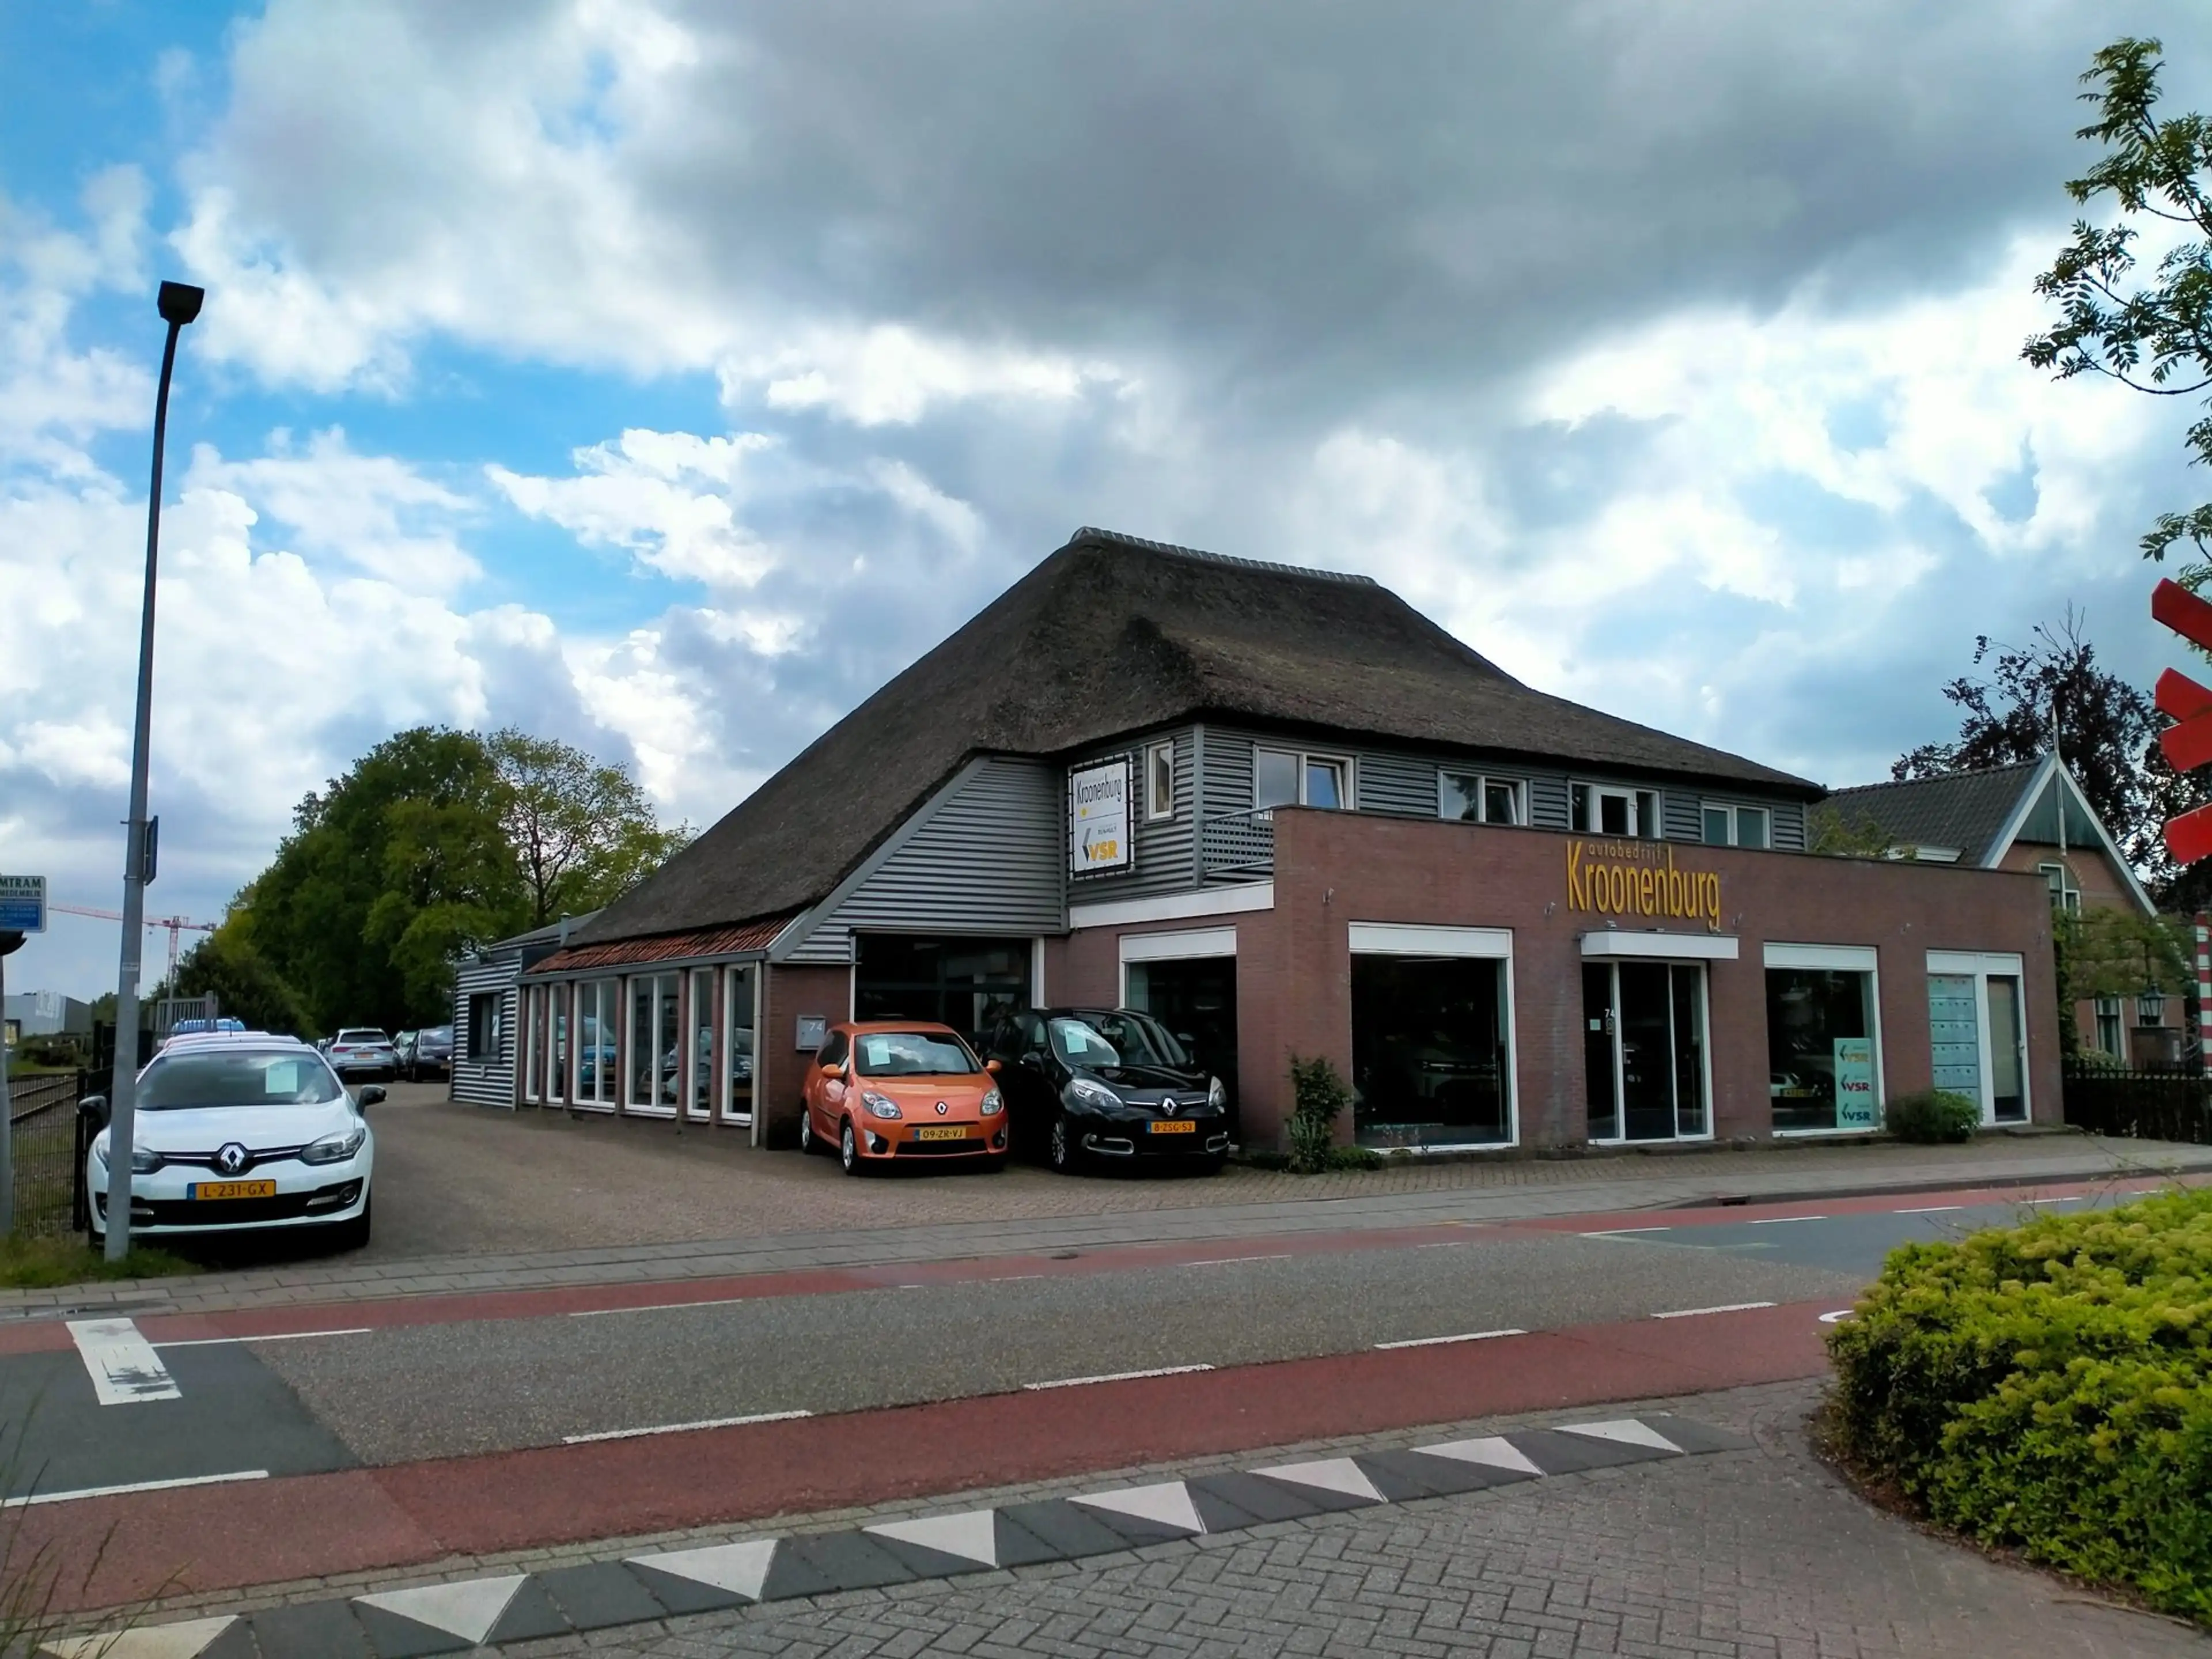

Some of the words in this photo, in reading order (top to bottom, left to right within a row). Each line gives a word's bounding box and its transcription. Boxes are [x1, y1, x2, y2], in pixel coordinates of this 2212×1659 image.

[1076, 772, 1122, 805] Kroonenburg
[1088, 839, 1118, 861] VSR
[1588, 839, 1661, 864] autobedrijf
[1566, 839, 1719, 930] Kroonenburg
[1604, 1008, 1615, 1018] 74
[809, 1022, 823, 1031] 74
[1846, 1082, 1870, 1092] VSR
[1847, 1110, 1871, 1121] VSR
[923, 1129, 963, 1139] 09-ZR-VJ
[204, 1183, 267, 1198] L-231-GX
